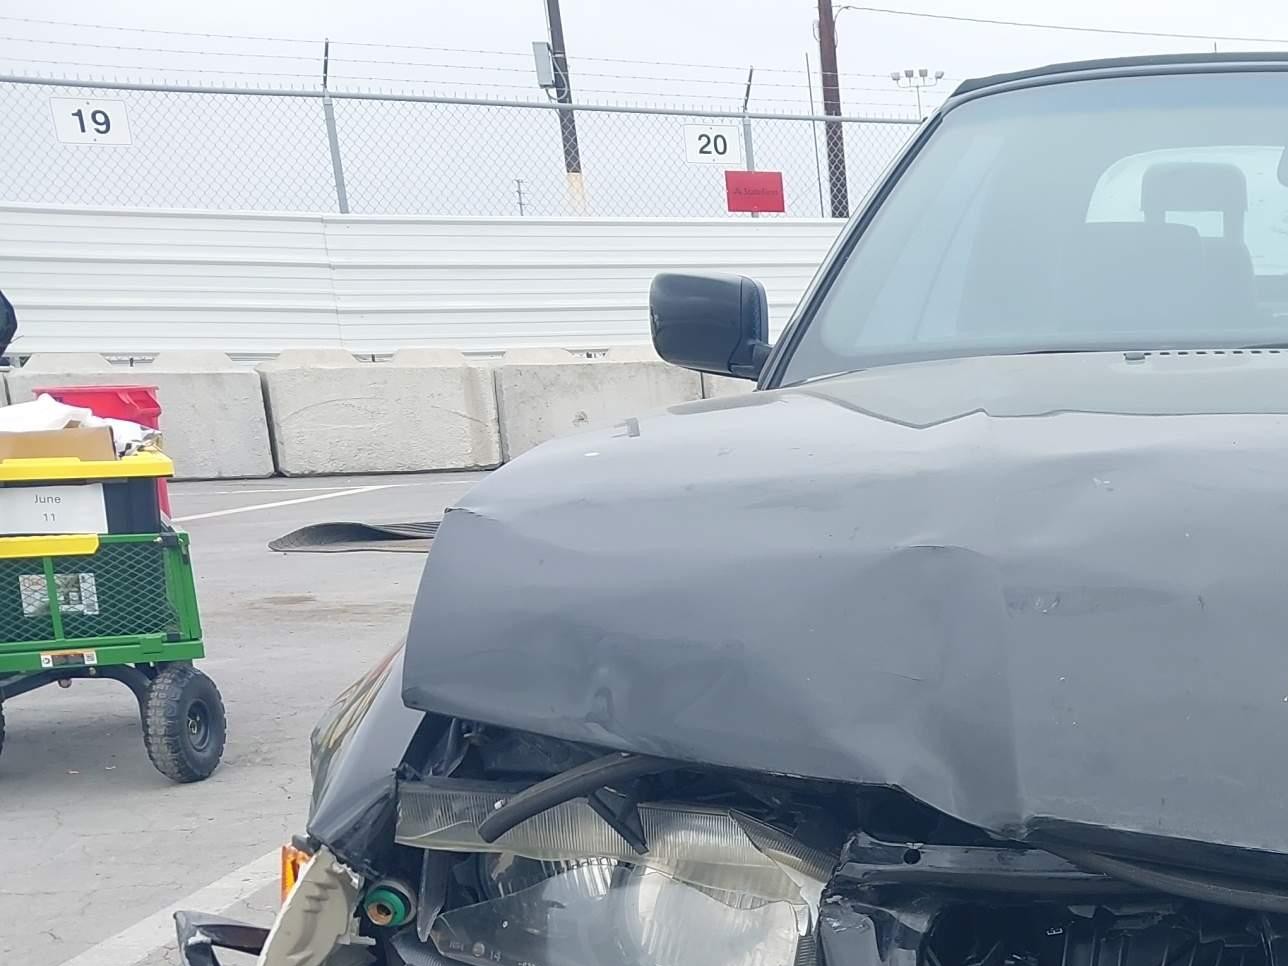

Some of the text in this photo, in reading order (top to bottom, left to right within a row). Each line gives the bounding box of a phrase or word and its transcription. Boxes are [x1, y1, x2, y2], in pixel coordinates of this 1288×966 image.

[71, 108, 111, 134] 19
[697, 133, 727, 155] 20
[34, 494, 62, 504] June
[43, 513, 56, 521] 11
